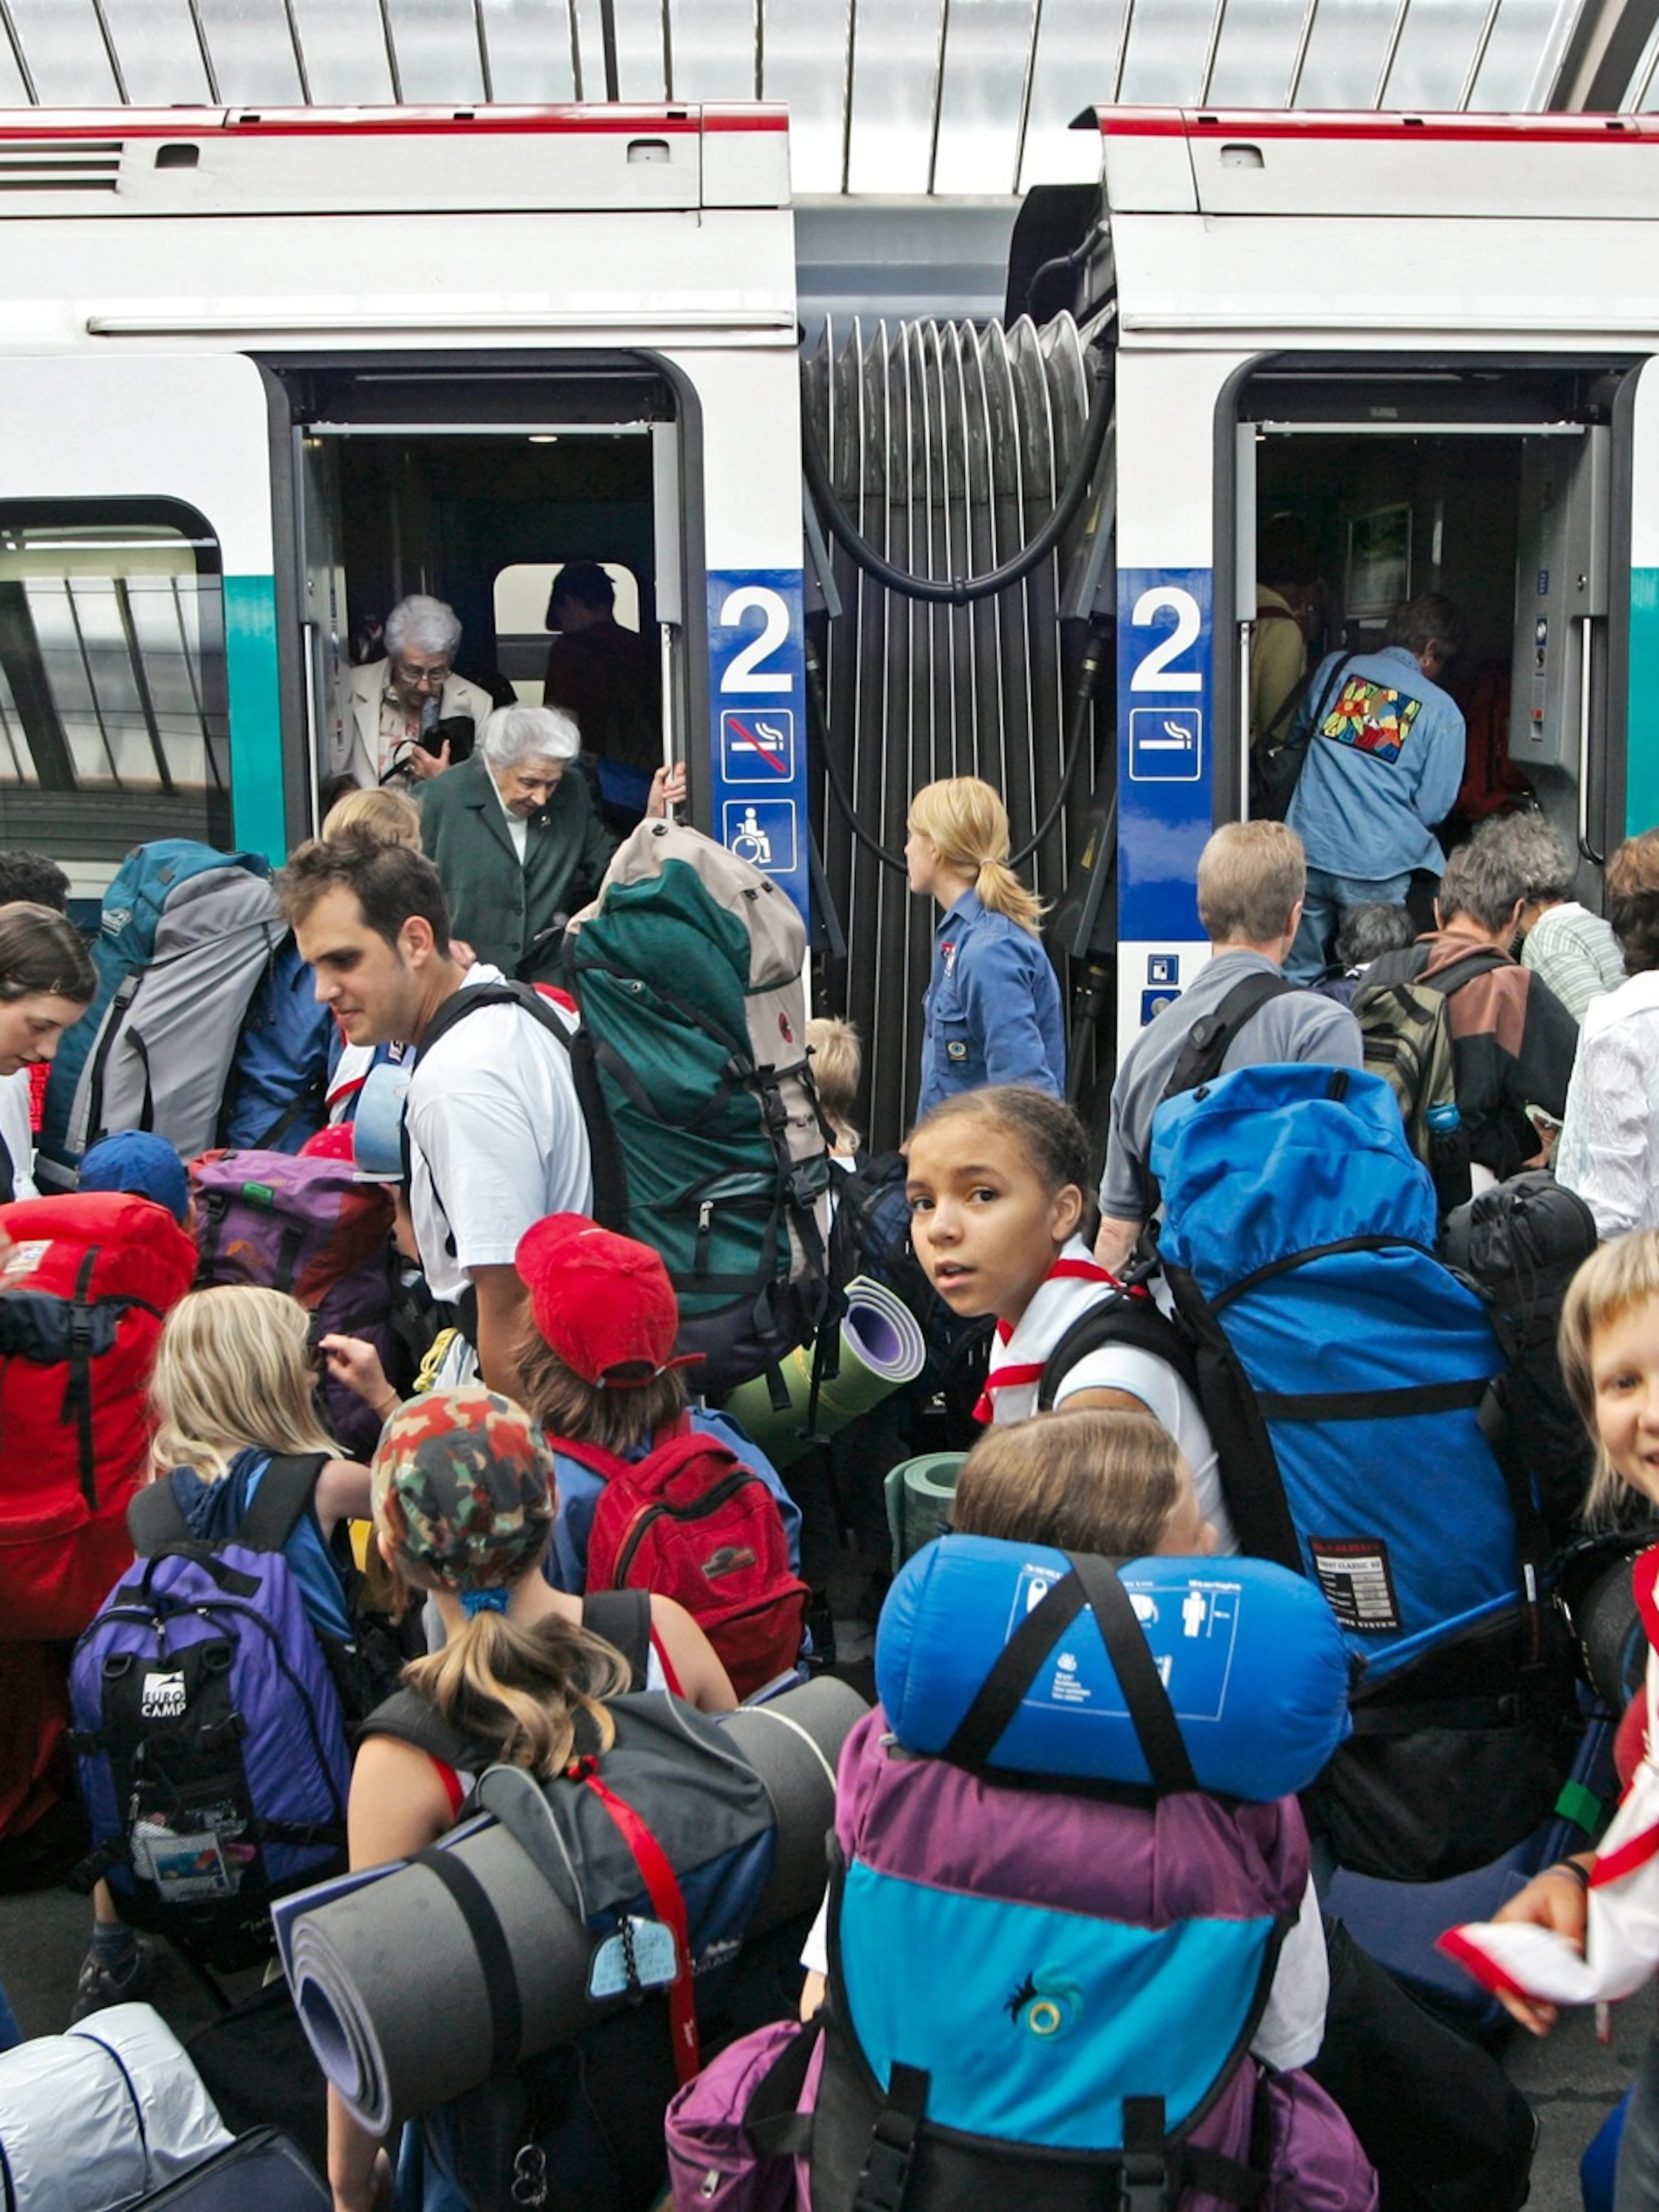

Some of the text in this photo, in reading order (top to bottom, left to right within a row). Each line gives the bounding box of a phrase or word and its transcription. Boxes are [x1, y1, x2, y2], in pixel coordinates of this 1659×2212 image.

[720, 586, 792, 693] 2
[1130, 586, 1202, 692] 2
[141, 1701, 187, 1717] CAMP
[145, 1690, 182, 1703] EURO
